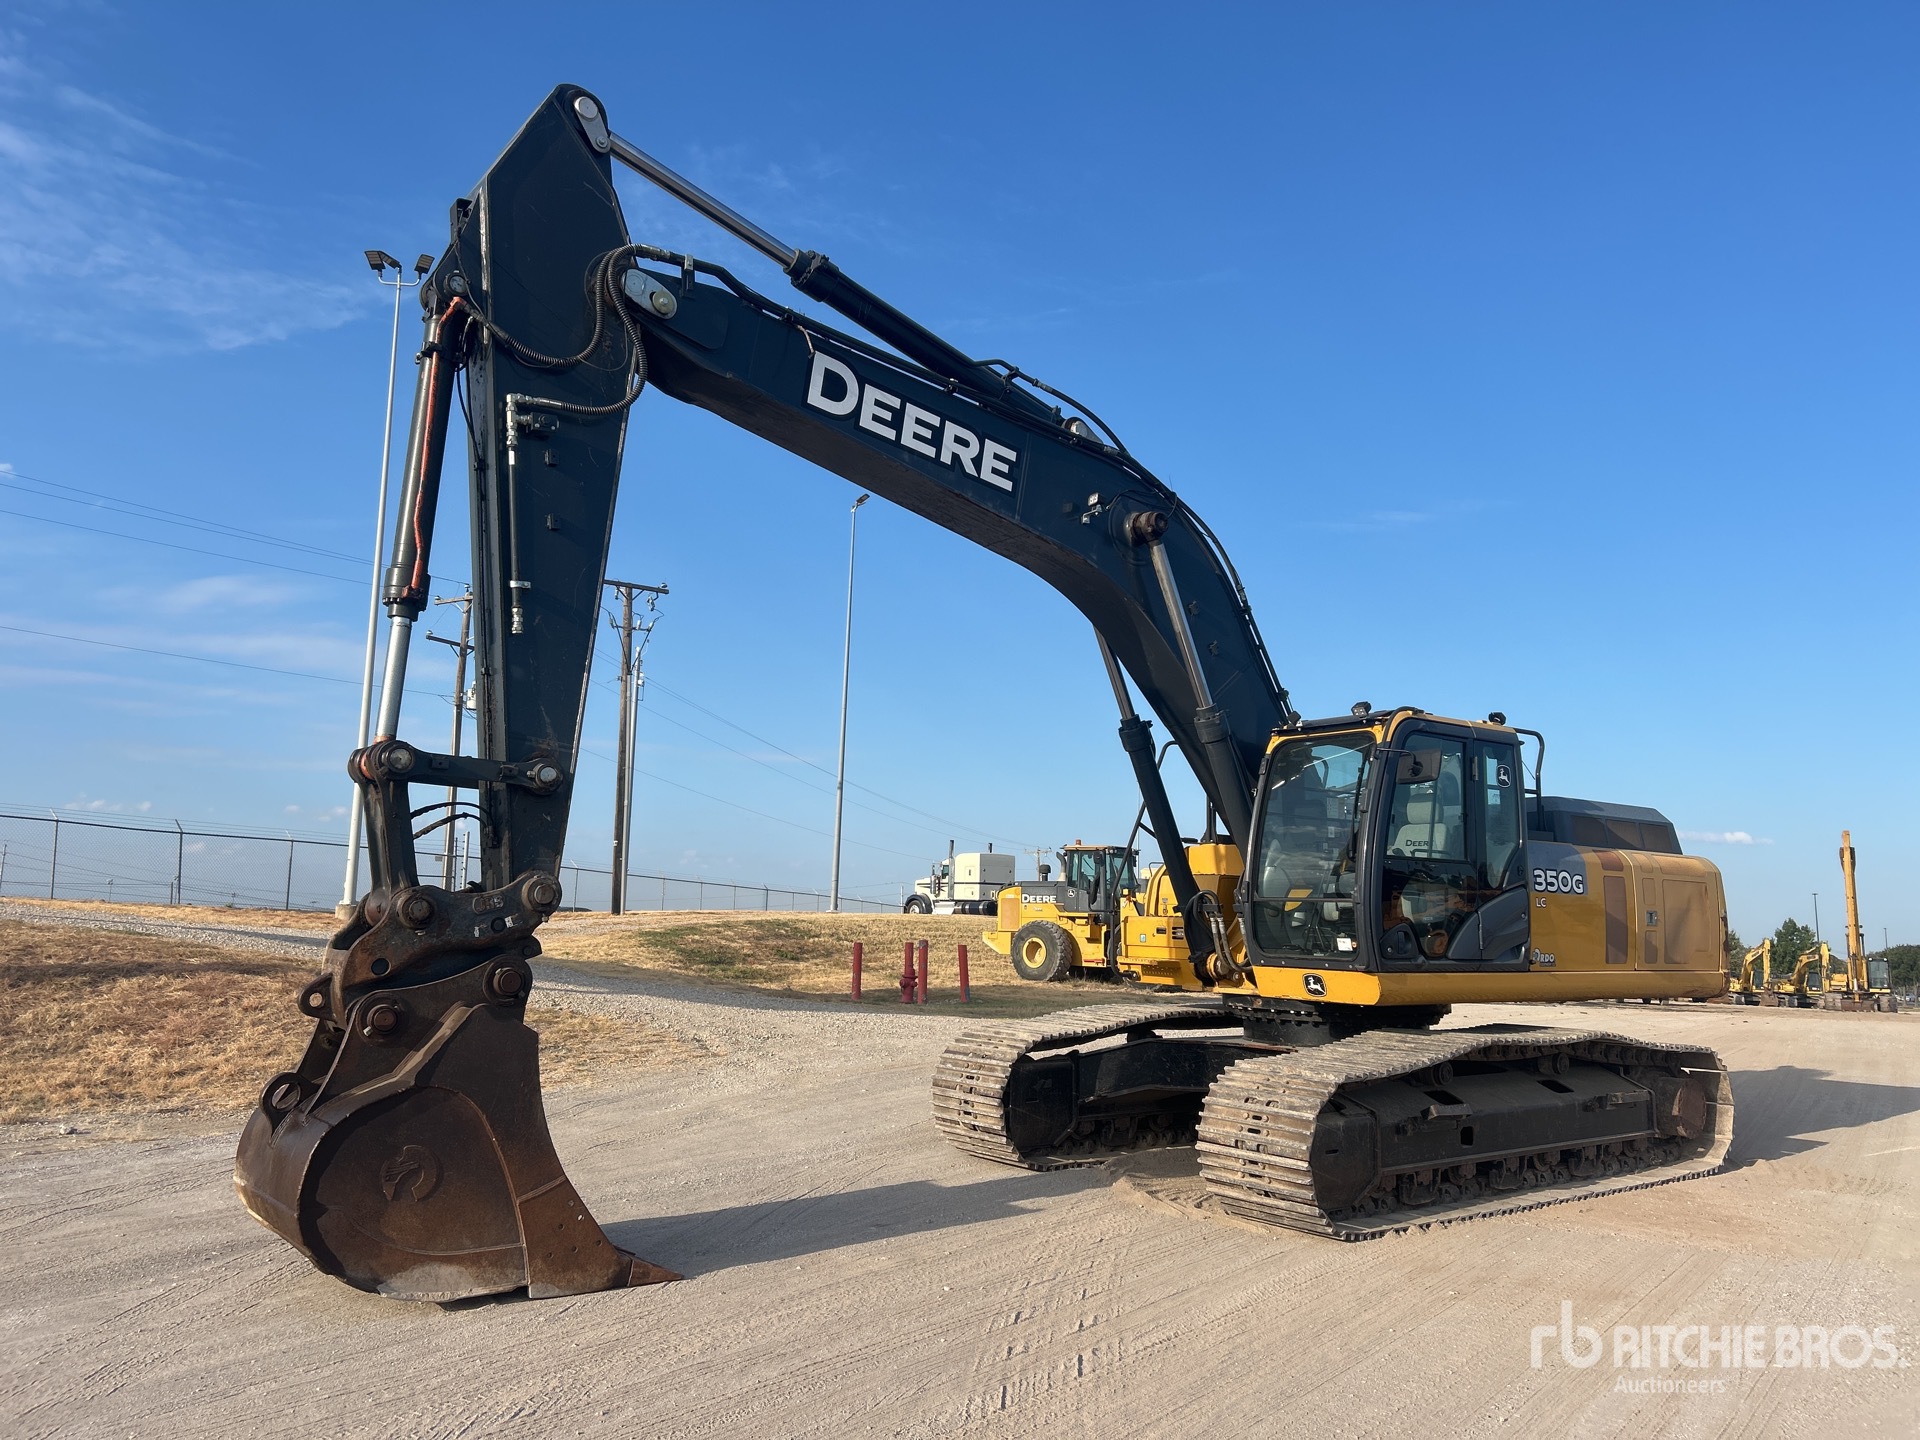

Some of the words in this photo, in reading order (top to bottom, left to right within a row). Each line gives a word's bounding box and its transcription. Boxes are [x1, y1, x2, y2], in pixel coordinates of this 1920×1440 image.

[807, 350, 1018, 492] DEERE
[1405, 839, 1430, 847] DEER
[1533, 869, 1585, 894] 350G
[1021, 893, 1057, 904] DEERE
[1535, 897, 1547, 908] LC
